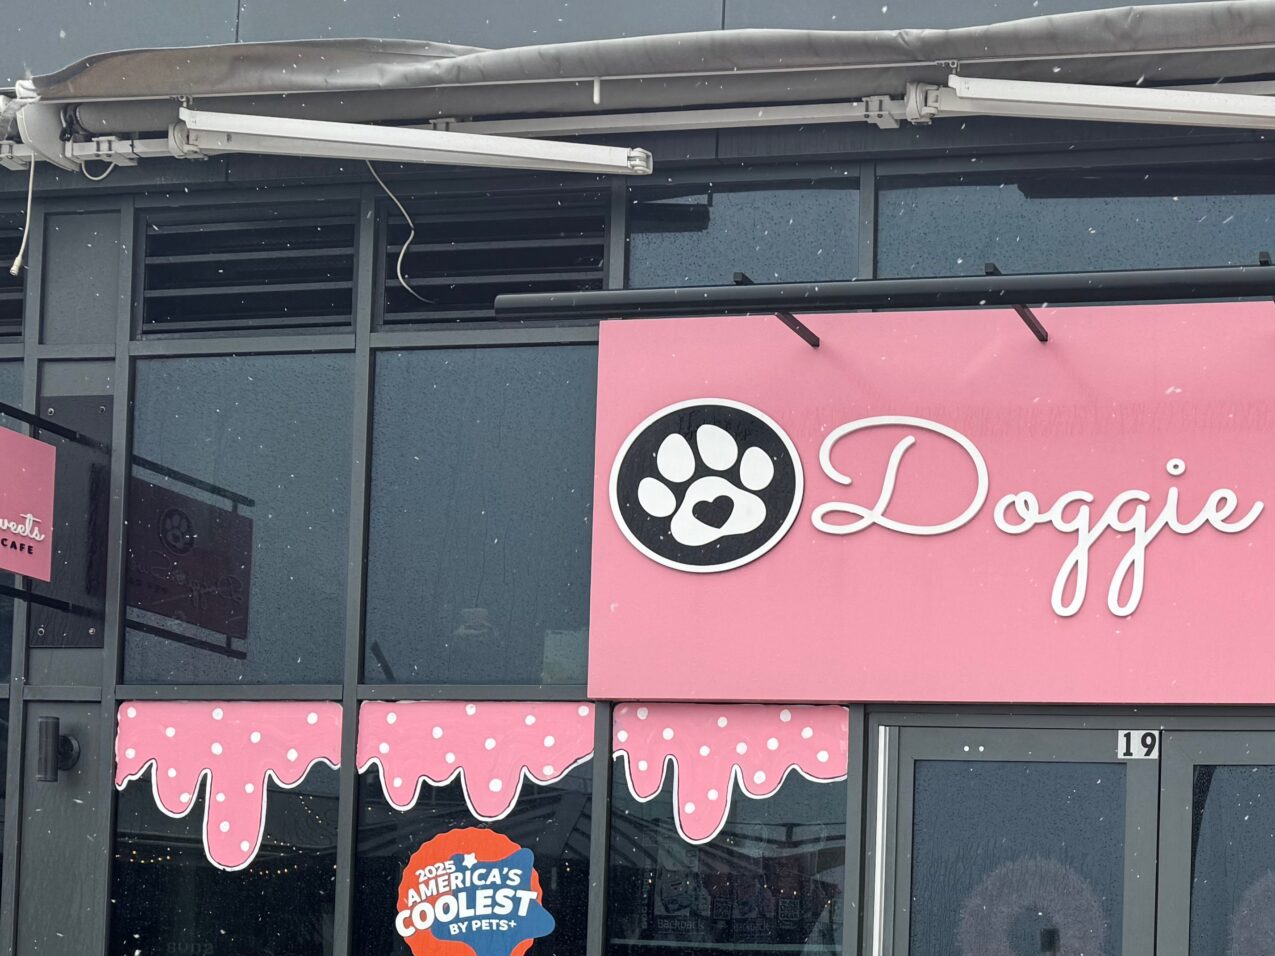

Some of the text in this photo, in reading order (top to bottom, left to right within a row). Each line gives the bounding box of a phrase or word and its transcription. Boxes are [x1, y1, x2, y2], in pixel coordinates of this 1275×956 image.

[0, 513, 45, 541] weets
[811, 415, 1265, 617] Doggie
[1, 538, 34, 555] CAFE
[1123, 732, 1157, 757] 19
[415, 860, 456, 883] 2025
[407, 867, 523, 907] AMERICA'S
[395, 888, 538, 937] COOLEST
[449, 919, 517, 935] BY PETS+
